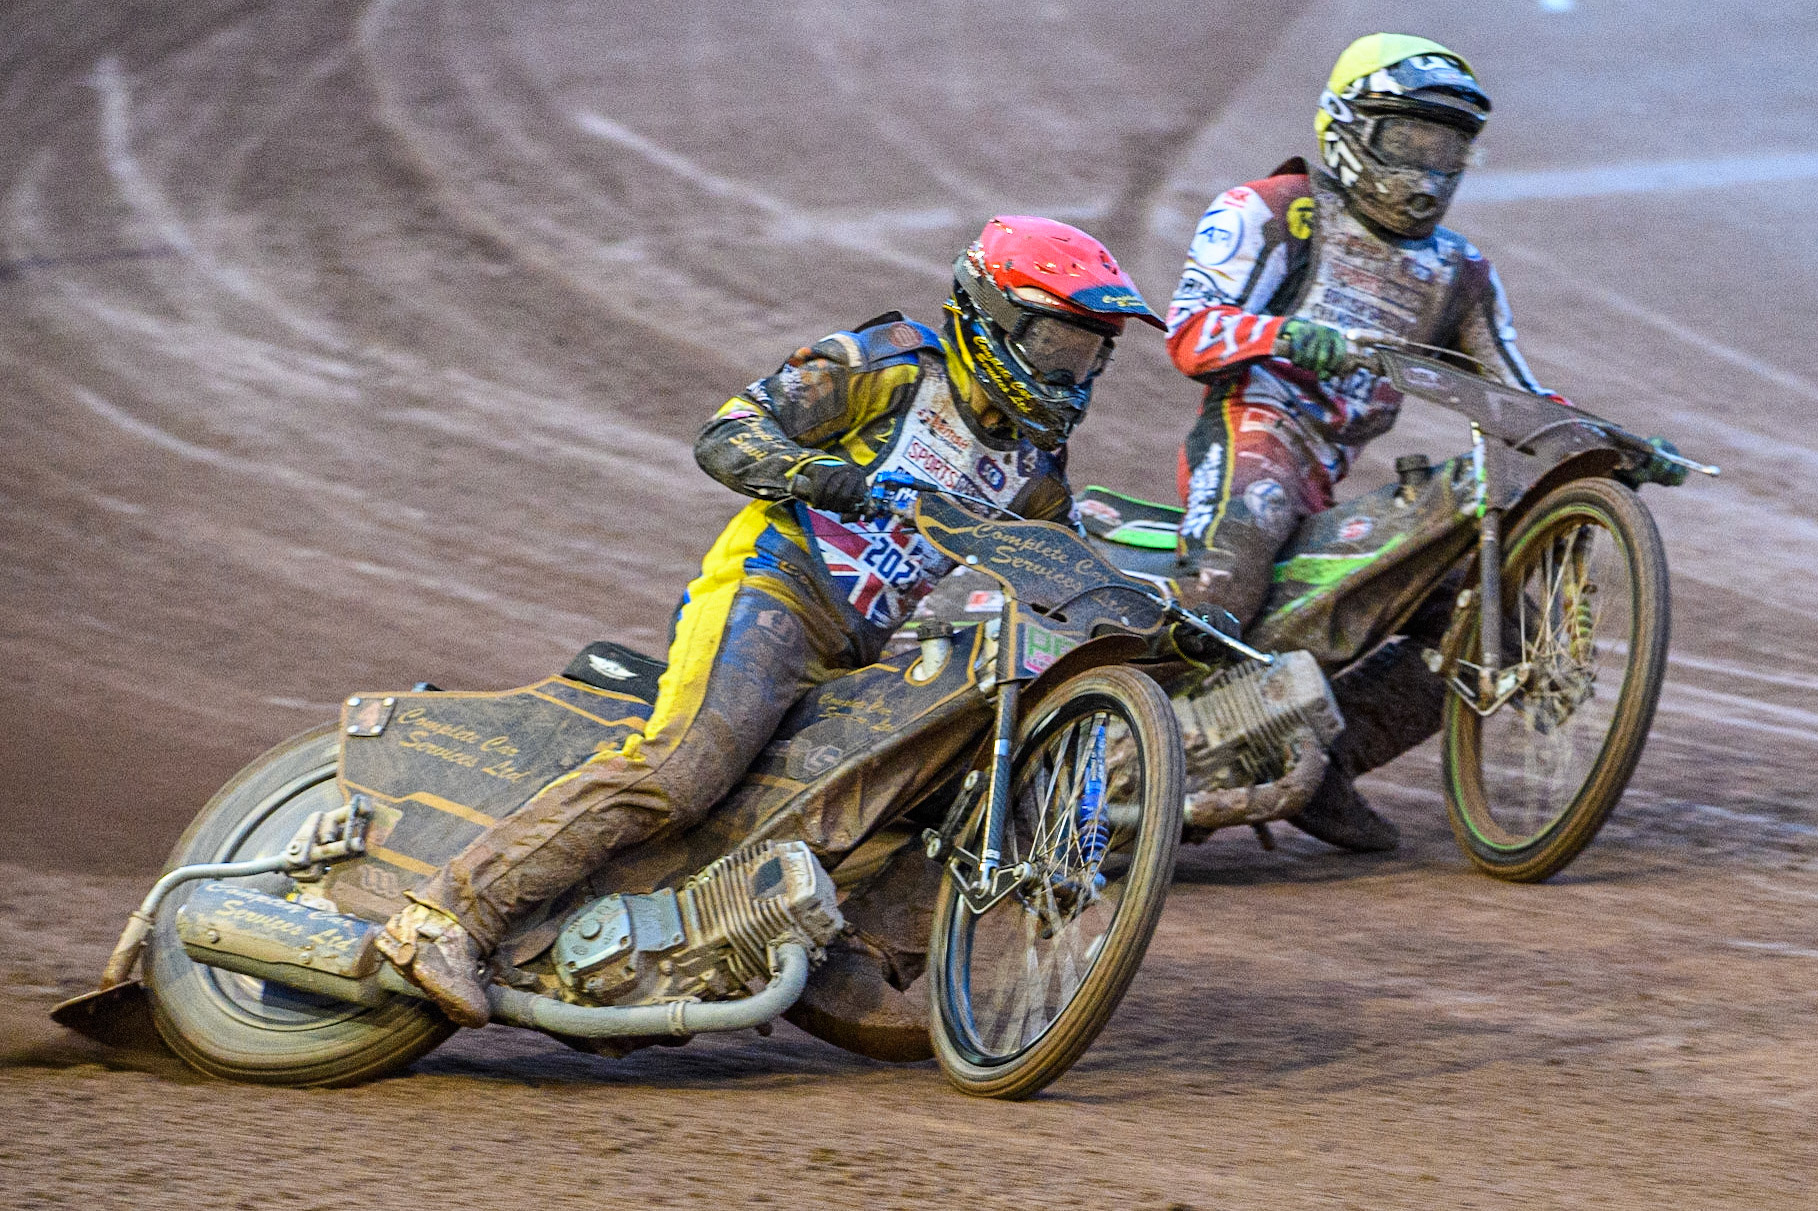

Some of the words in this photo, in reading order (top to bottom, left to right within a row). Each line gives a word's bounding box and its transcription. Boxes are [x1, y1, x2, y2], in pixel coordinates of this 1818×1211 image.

[907, 441, 957, 489] SPORTS
[864, 536, 917, 591] 202
[972, 523, 1069, 564] Complete
[990, 544, 1082, 592] Services
[398, 707, 481, 744] Complete
[400, 730, 480, 768] Services
[481, 759, 534, 783] Ltd
[215, 899, 304, 936] Services
